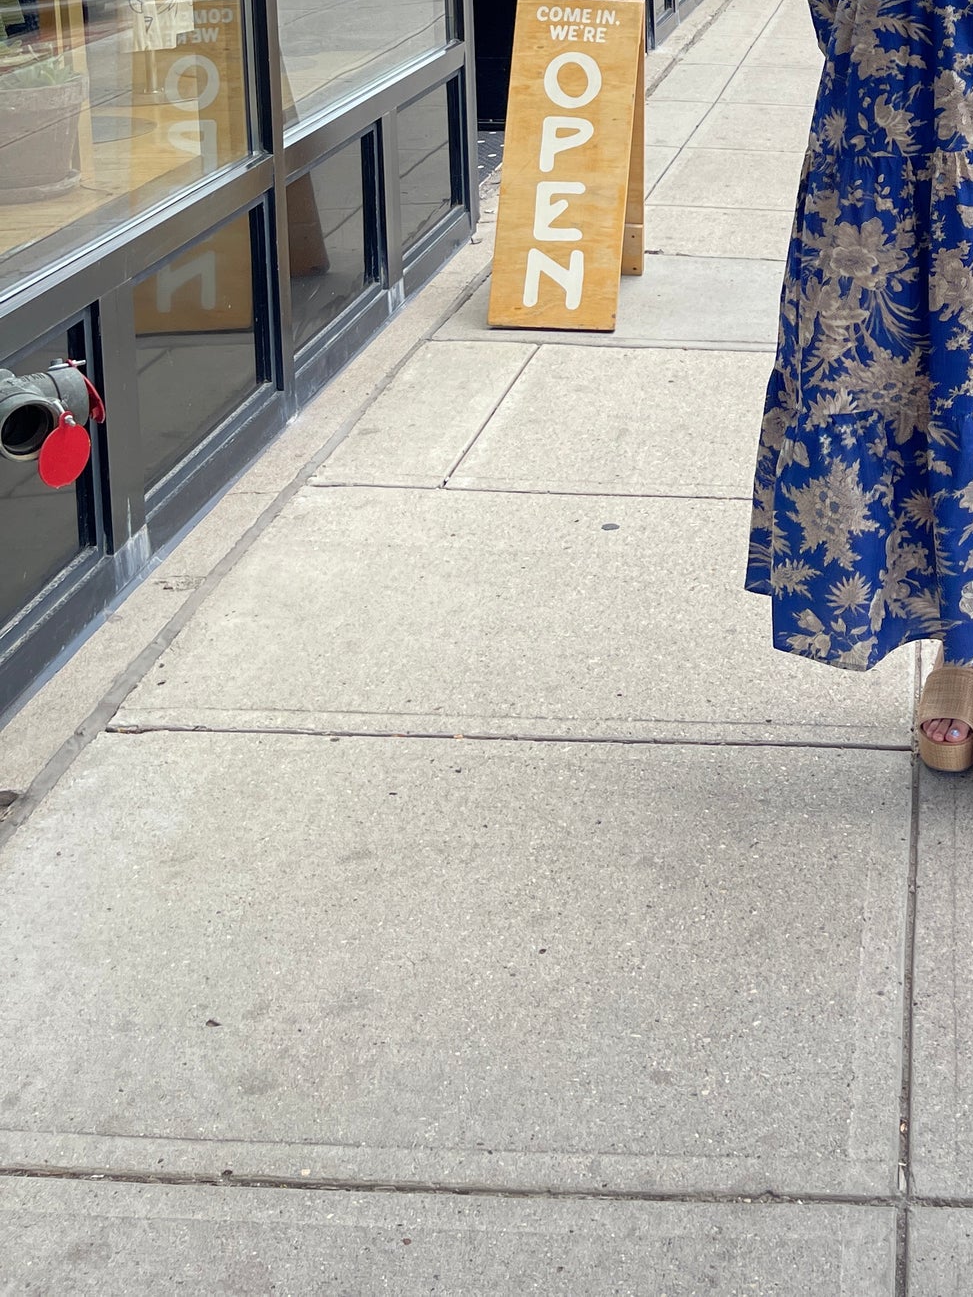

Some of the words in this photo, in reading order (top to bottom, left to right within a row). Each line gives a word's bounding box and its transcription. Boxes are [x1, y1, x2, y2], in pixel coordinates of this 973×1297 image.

[536, 5, 592, 24] COME
[549, 24, 607, 43] WE'RE
[522, 51, 602, 310] OPEN
